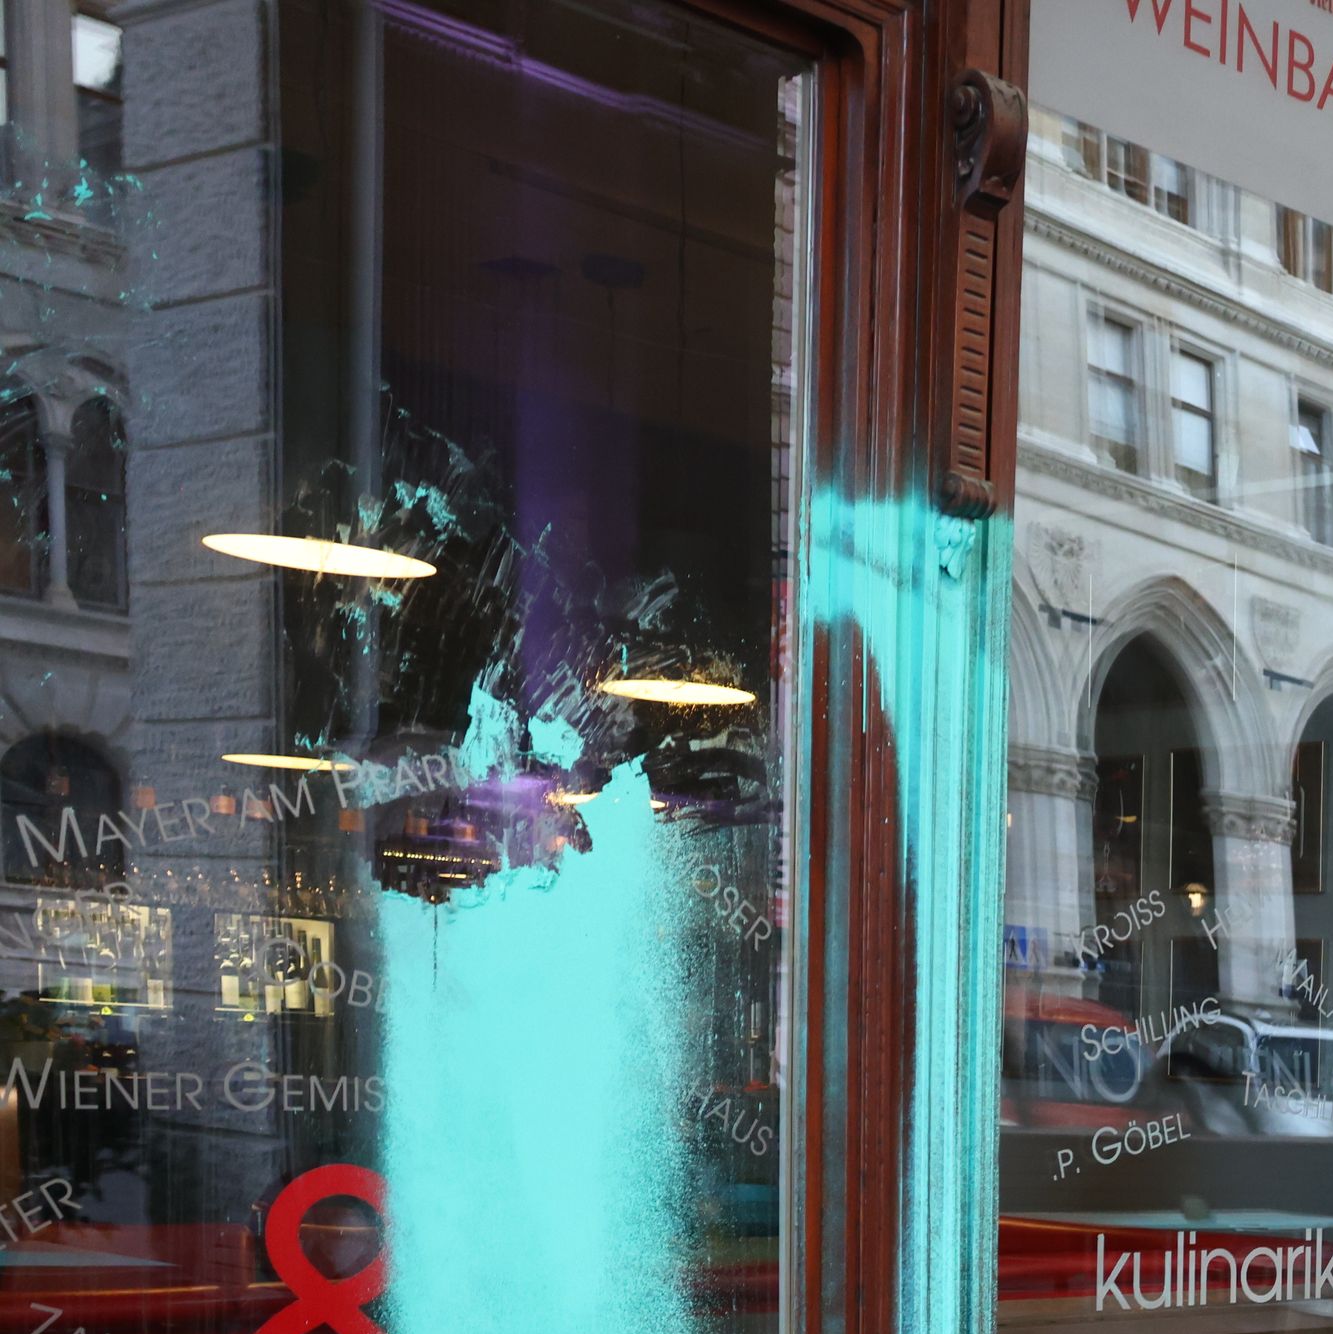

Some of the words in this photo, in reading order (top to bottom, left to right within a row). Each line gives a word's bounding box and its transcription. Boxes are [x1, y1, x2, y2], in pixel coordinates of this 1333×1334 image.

[16, 799, 212, 867] MAYER
[239, 778, 315, 829] AM
[1071, 889, 1166, 965] KROISS
[1081, 996, 1221, 1062] SCHILLING
[0, 1056, 202, 1111] WIENER
[1092, 1112, 1192, 1165] GÖBEL
[0, 1177, 83, 1251] TER
